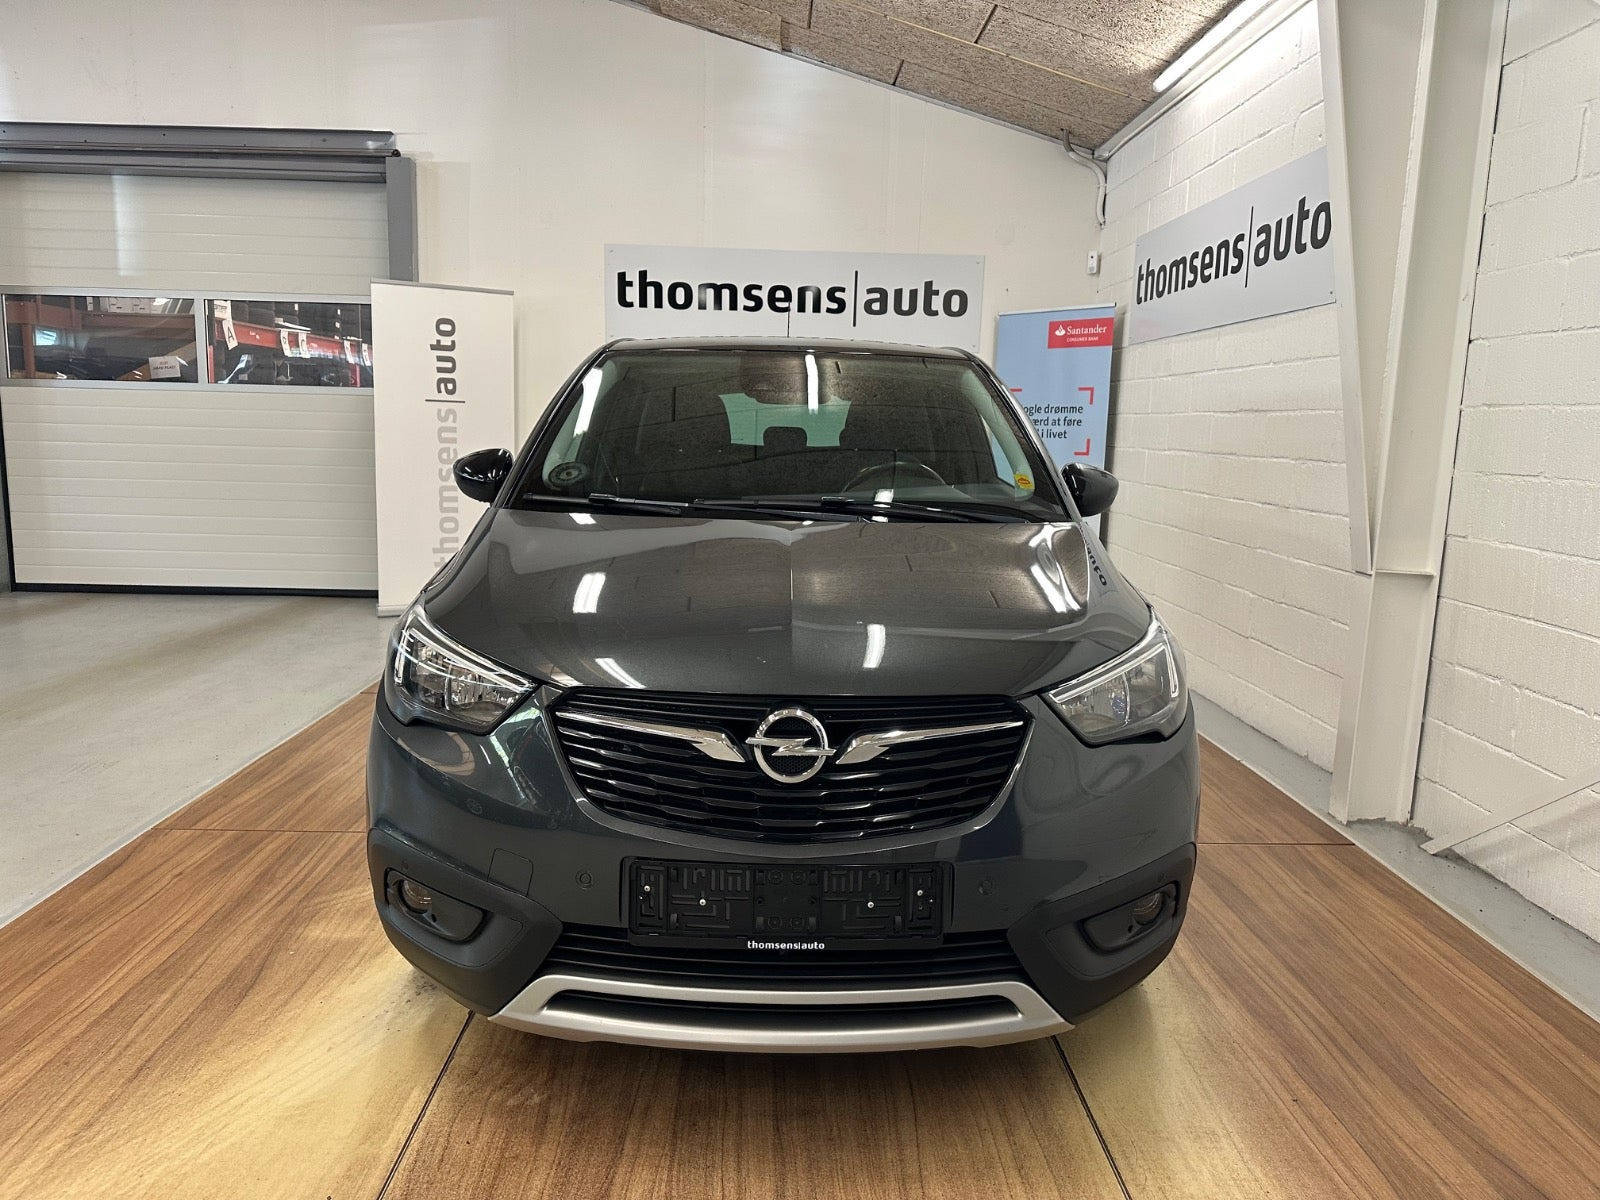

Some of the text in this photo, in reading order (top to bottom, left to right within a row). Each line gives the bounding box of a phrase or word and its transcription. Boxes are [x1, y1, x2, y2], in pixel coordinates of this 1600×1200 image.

[1066, 323, 1108, 335] Santander
[1023, 403, 1084, 416] ogle drømme
[1033, 416, 1082, 427] ærd at føre
[1046, 428, 1067, 439] livet
